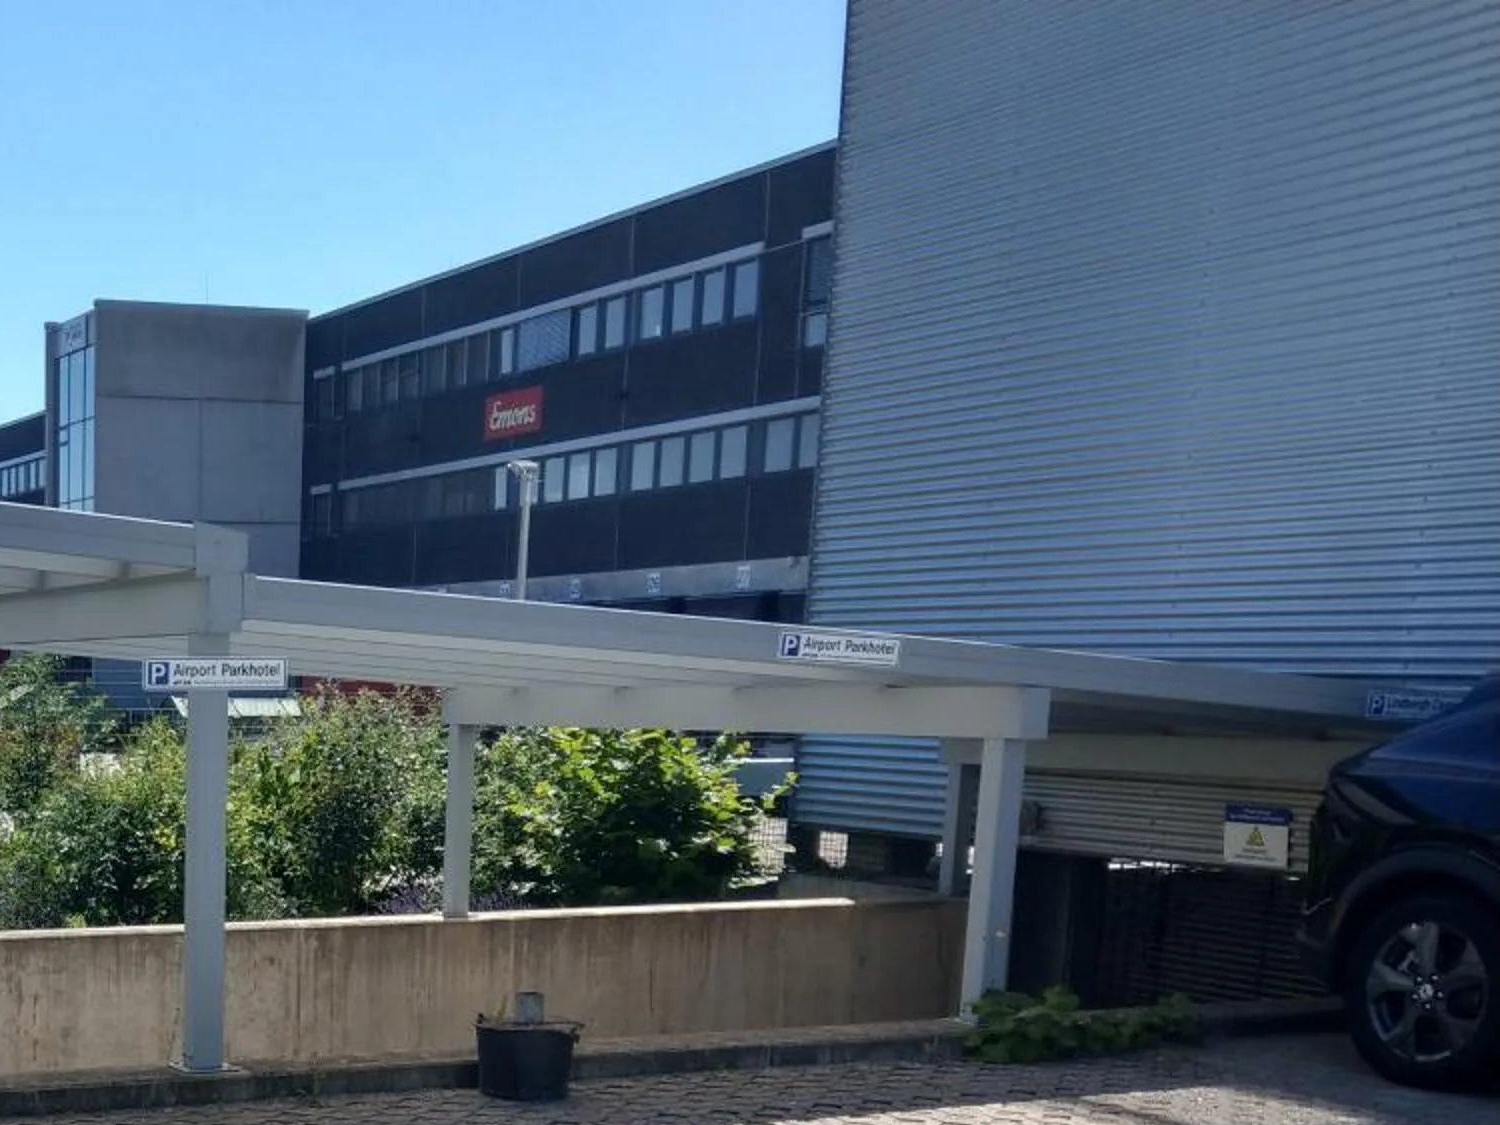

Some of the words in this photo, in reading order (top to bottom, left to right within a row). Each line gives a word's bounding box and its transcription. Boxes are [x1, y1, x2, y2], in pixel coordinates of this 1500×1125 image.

[783, 635, 798, 655] P
[802, 636, 841, 653] Airport
[845, 639, 894, 655] Parkhotel
[151, 663, 166, 685] P
[174, 663, 216, 678] Airport
[221, 663, 280, 677] Parkhotel
